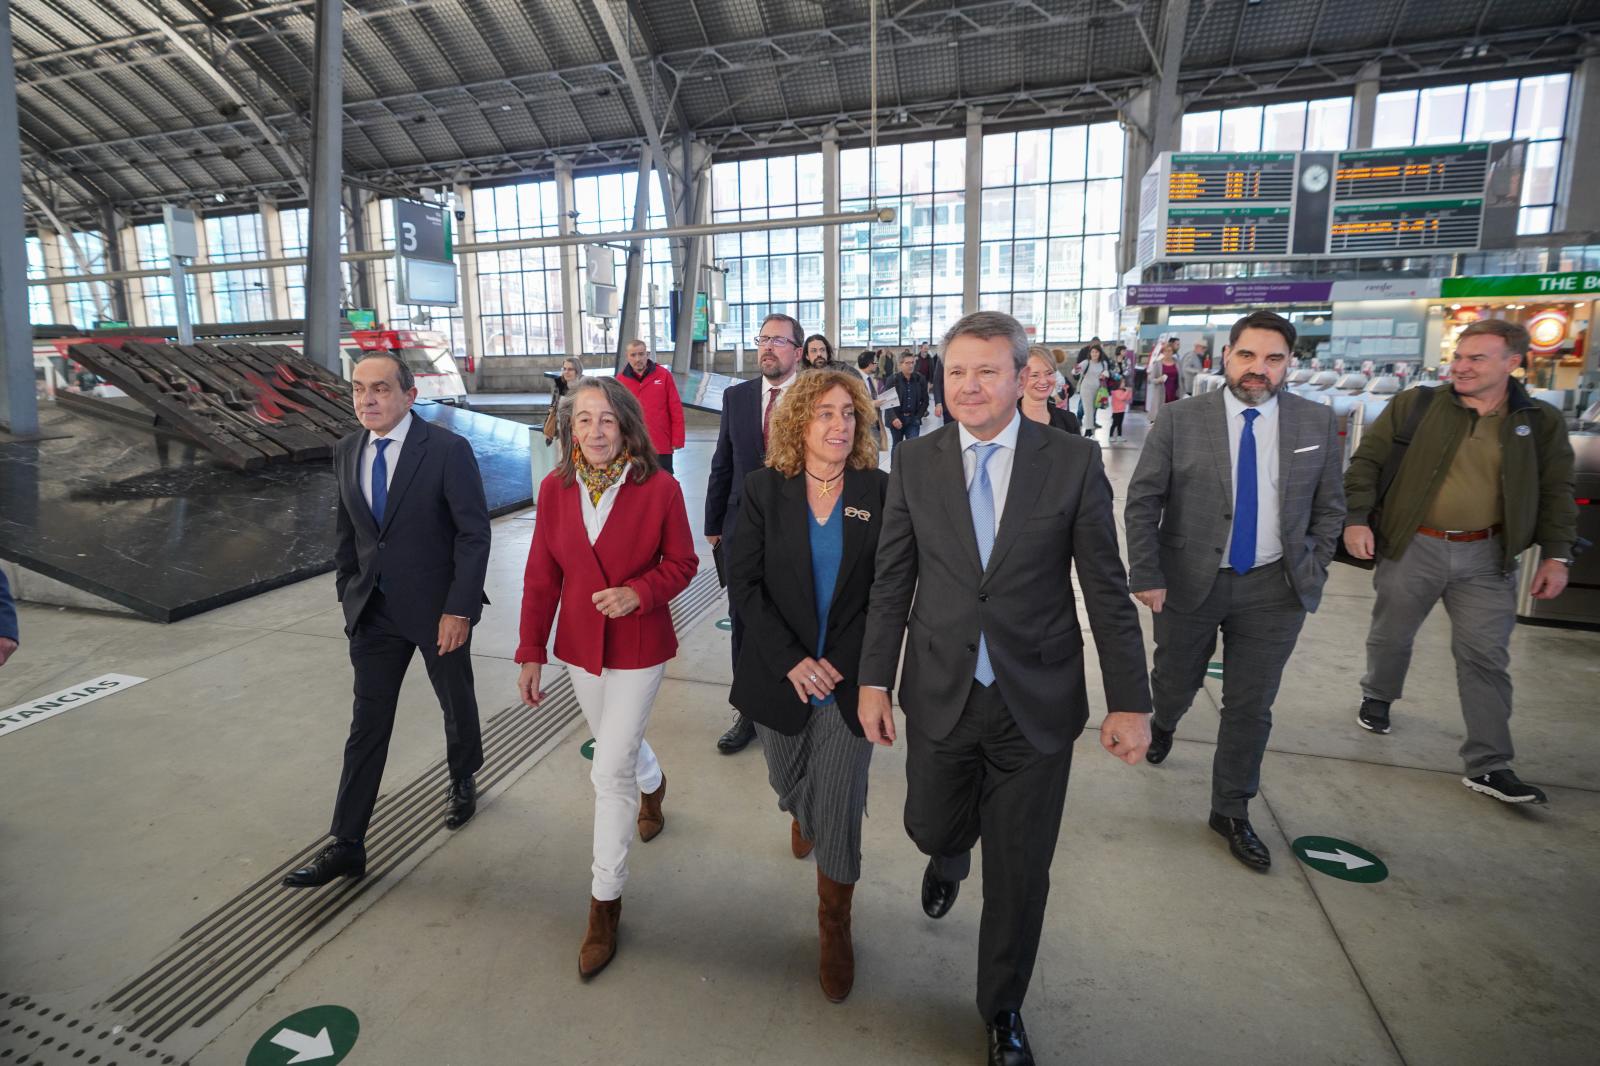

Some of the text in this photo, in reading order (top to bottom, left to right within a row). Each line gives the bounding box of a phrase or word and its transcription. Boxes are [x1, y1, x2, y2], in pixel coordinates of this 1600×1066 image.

[401, 222, 418, 251] 3
[590, 259, 599, 279] 2
[1538, 275, 1600, 291] THE B
